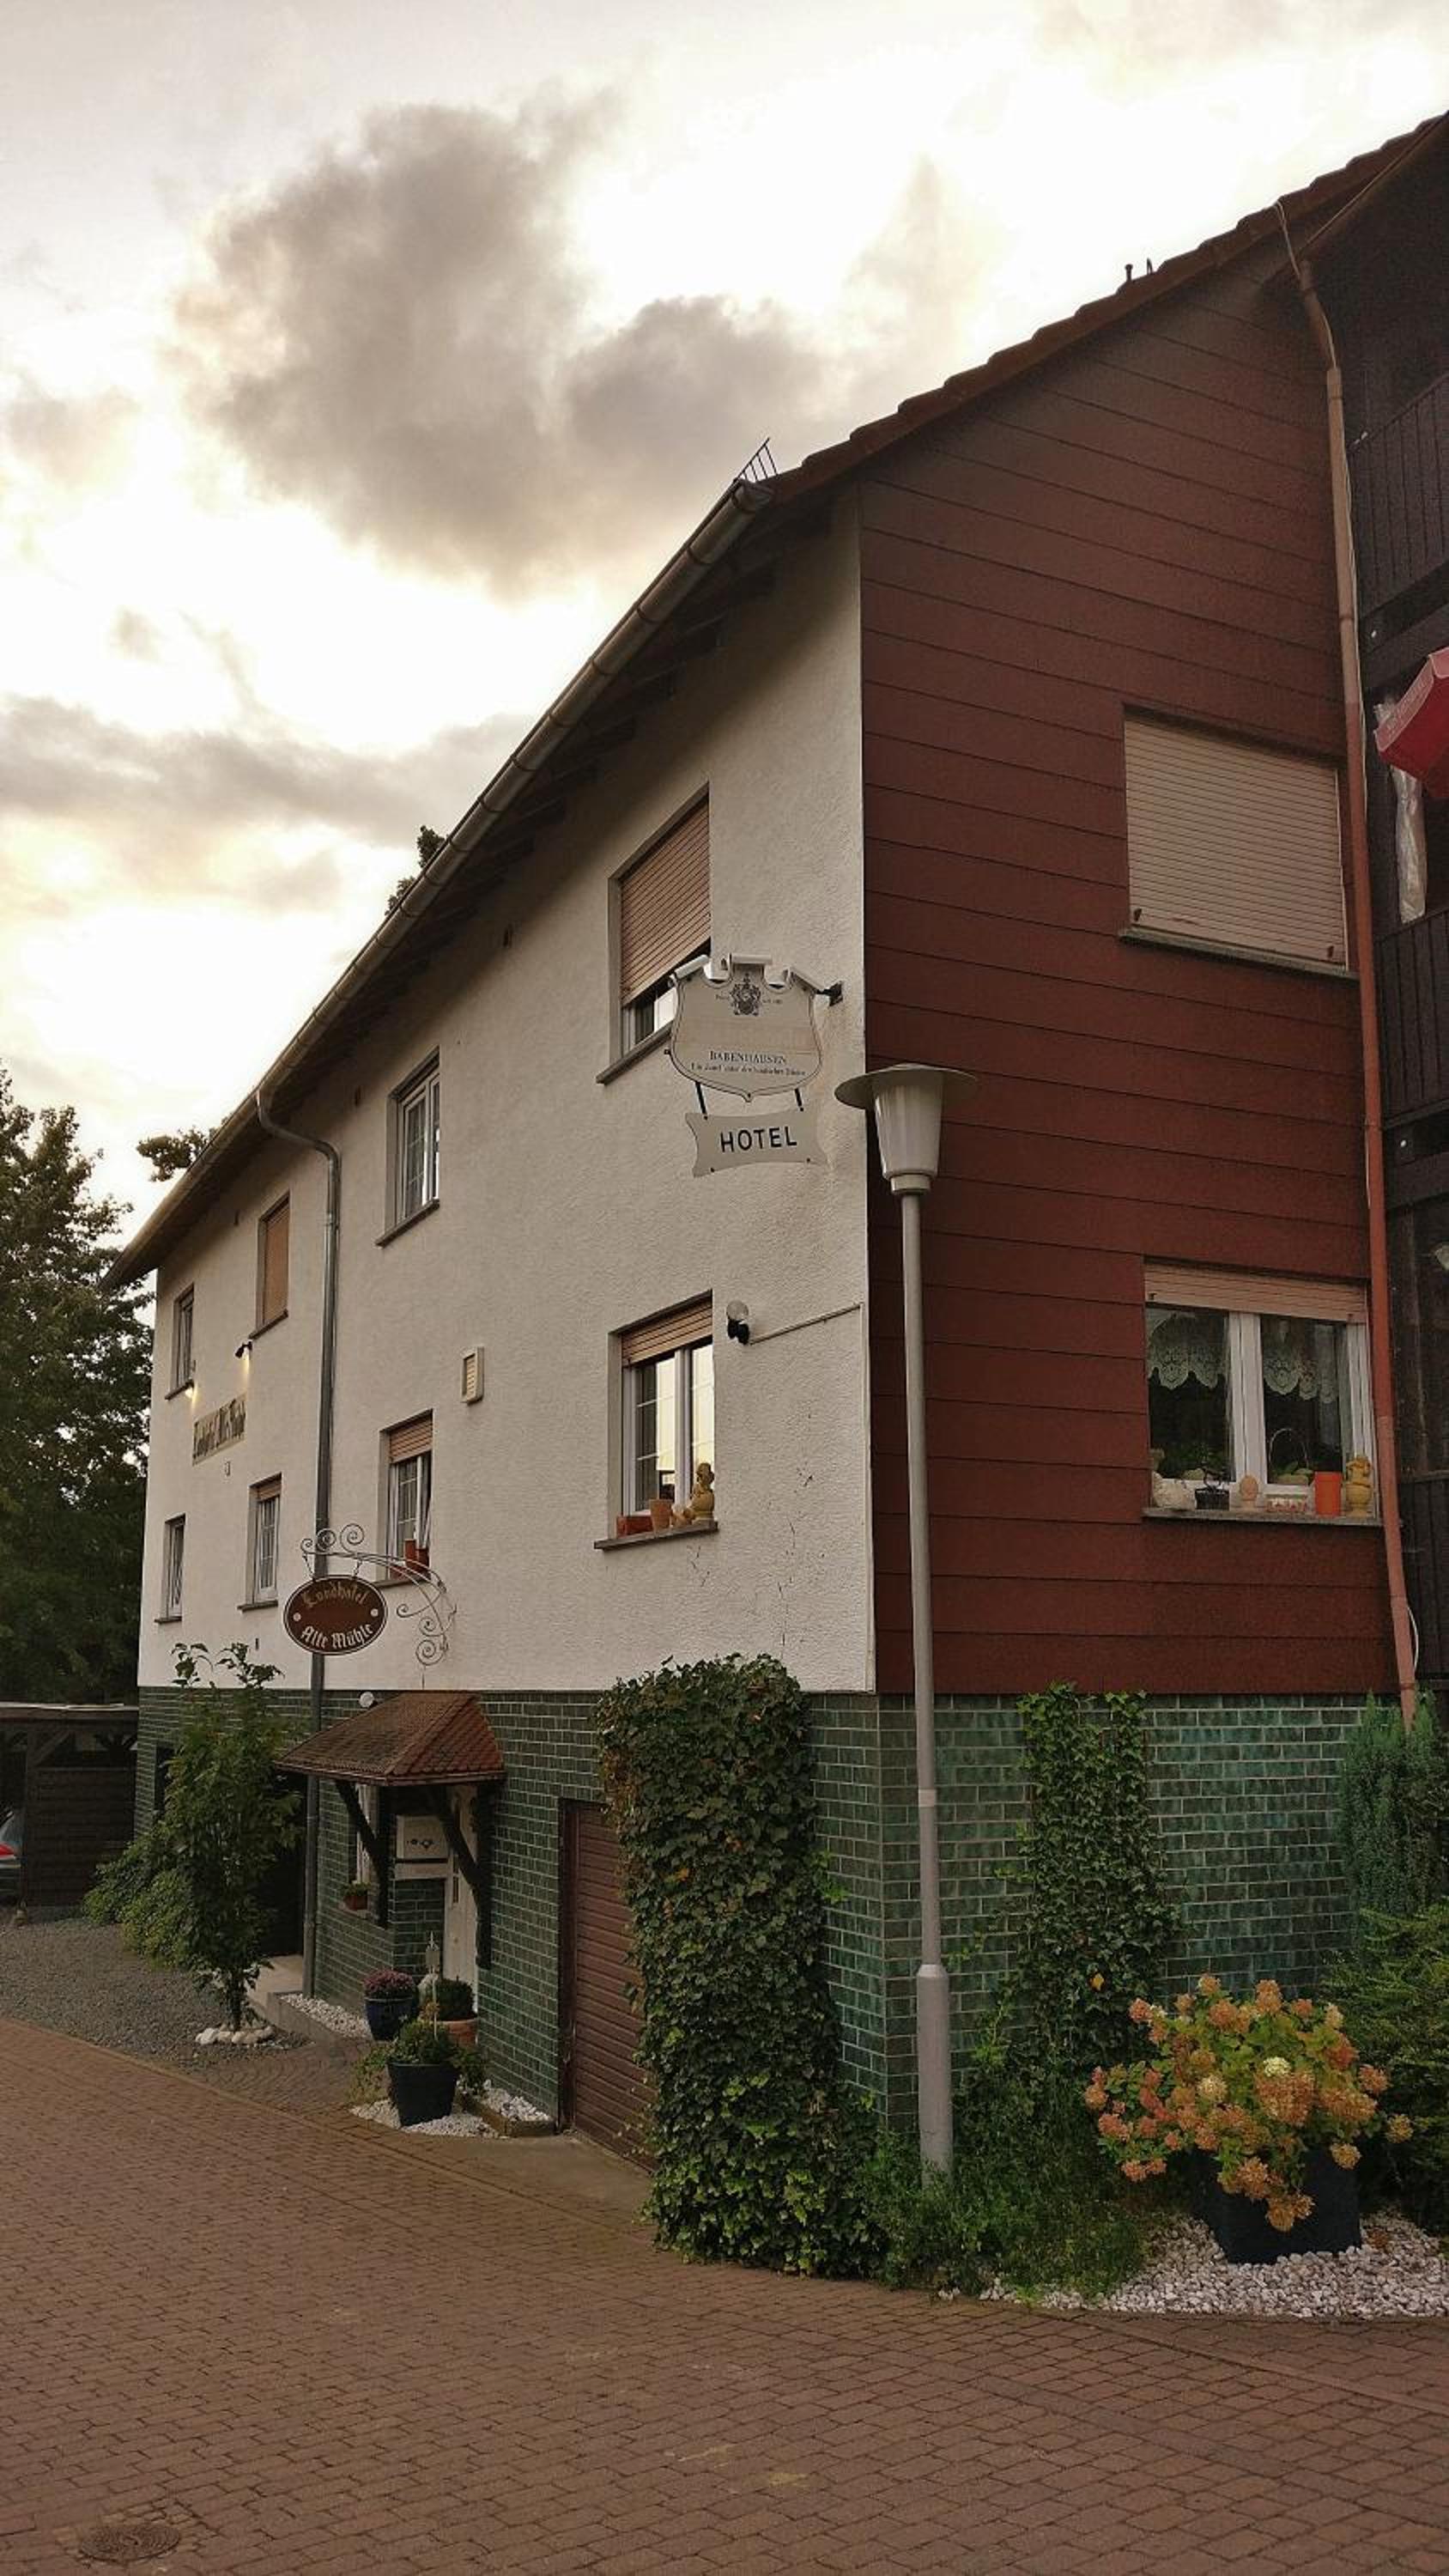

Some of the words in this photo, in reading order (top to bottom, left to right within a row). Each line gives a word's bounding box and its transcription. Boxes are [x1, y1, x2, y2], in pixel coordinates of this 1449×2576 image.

[720, 1126, 797, 1152] HOTEL
[300, 1625, 328, 1649] Alte
[331, 1623, 373, 1649] Mühle
